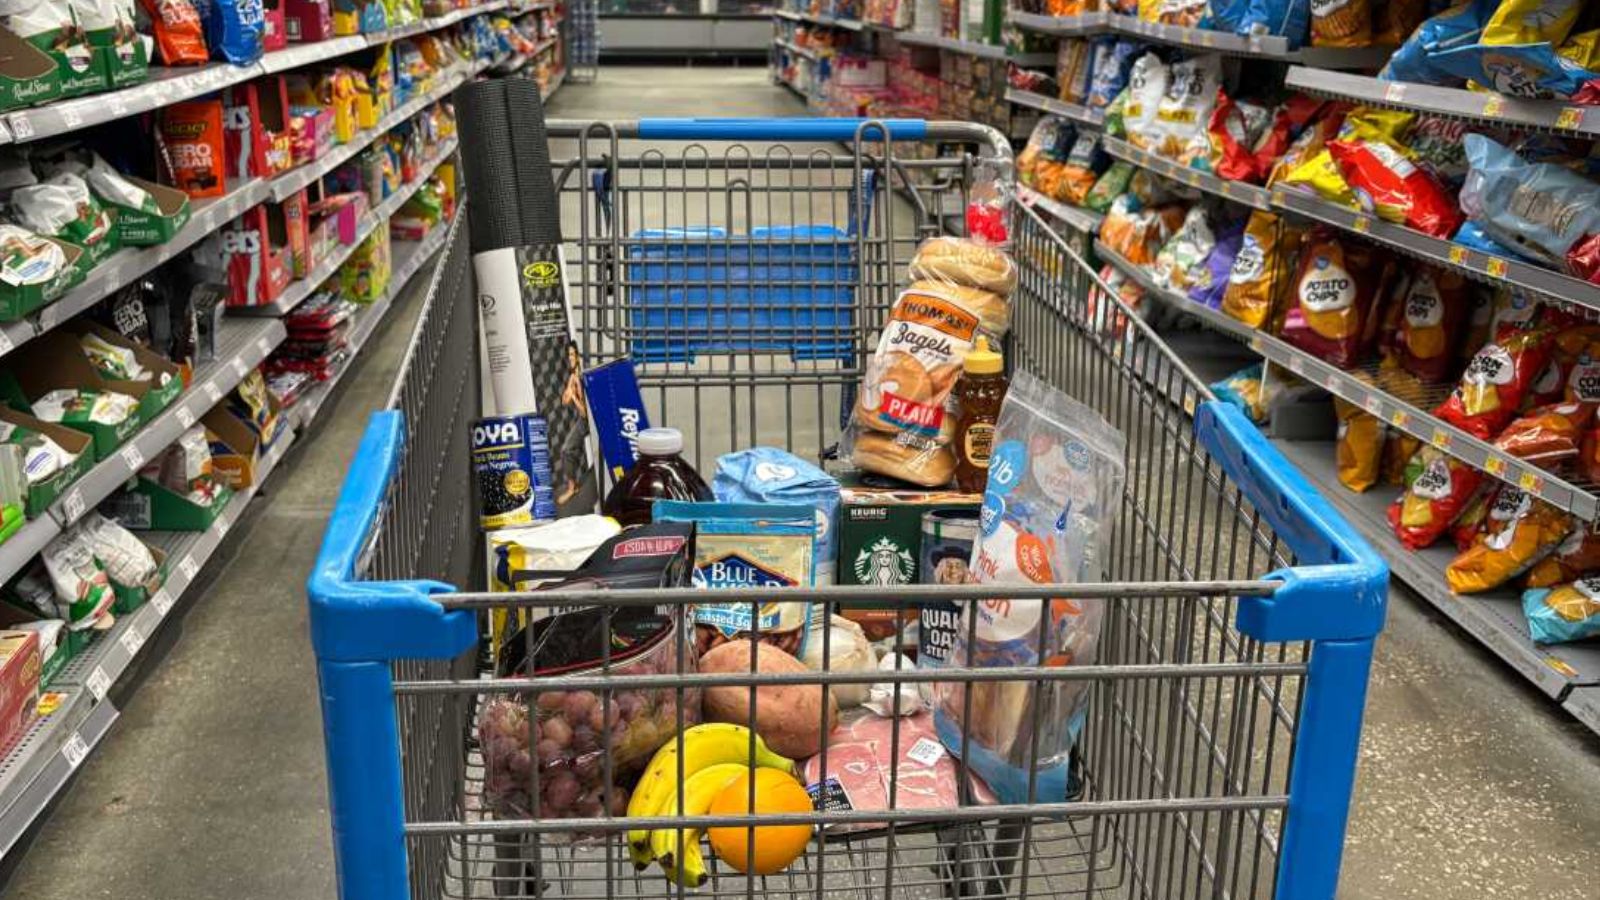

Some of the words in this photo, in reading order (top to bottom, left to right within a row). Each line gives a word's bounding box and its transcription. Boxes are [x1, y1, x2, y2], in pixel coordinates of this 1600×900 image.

[890, 322, 953, 356] Bagels
[887, 398, 936, 427] PLAIN
[472, 422, 519, 447] OYA
[850, 507, 887, 517] KEURIG
[711, 561, 757, 583] BLUE
